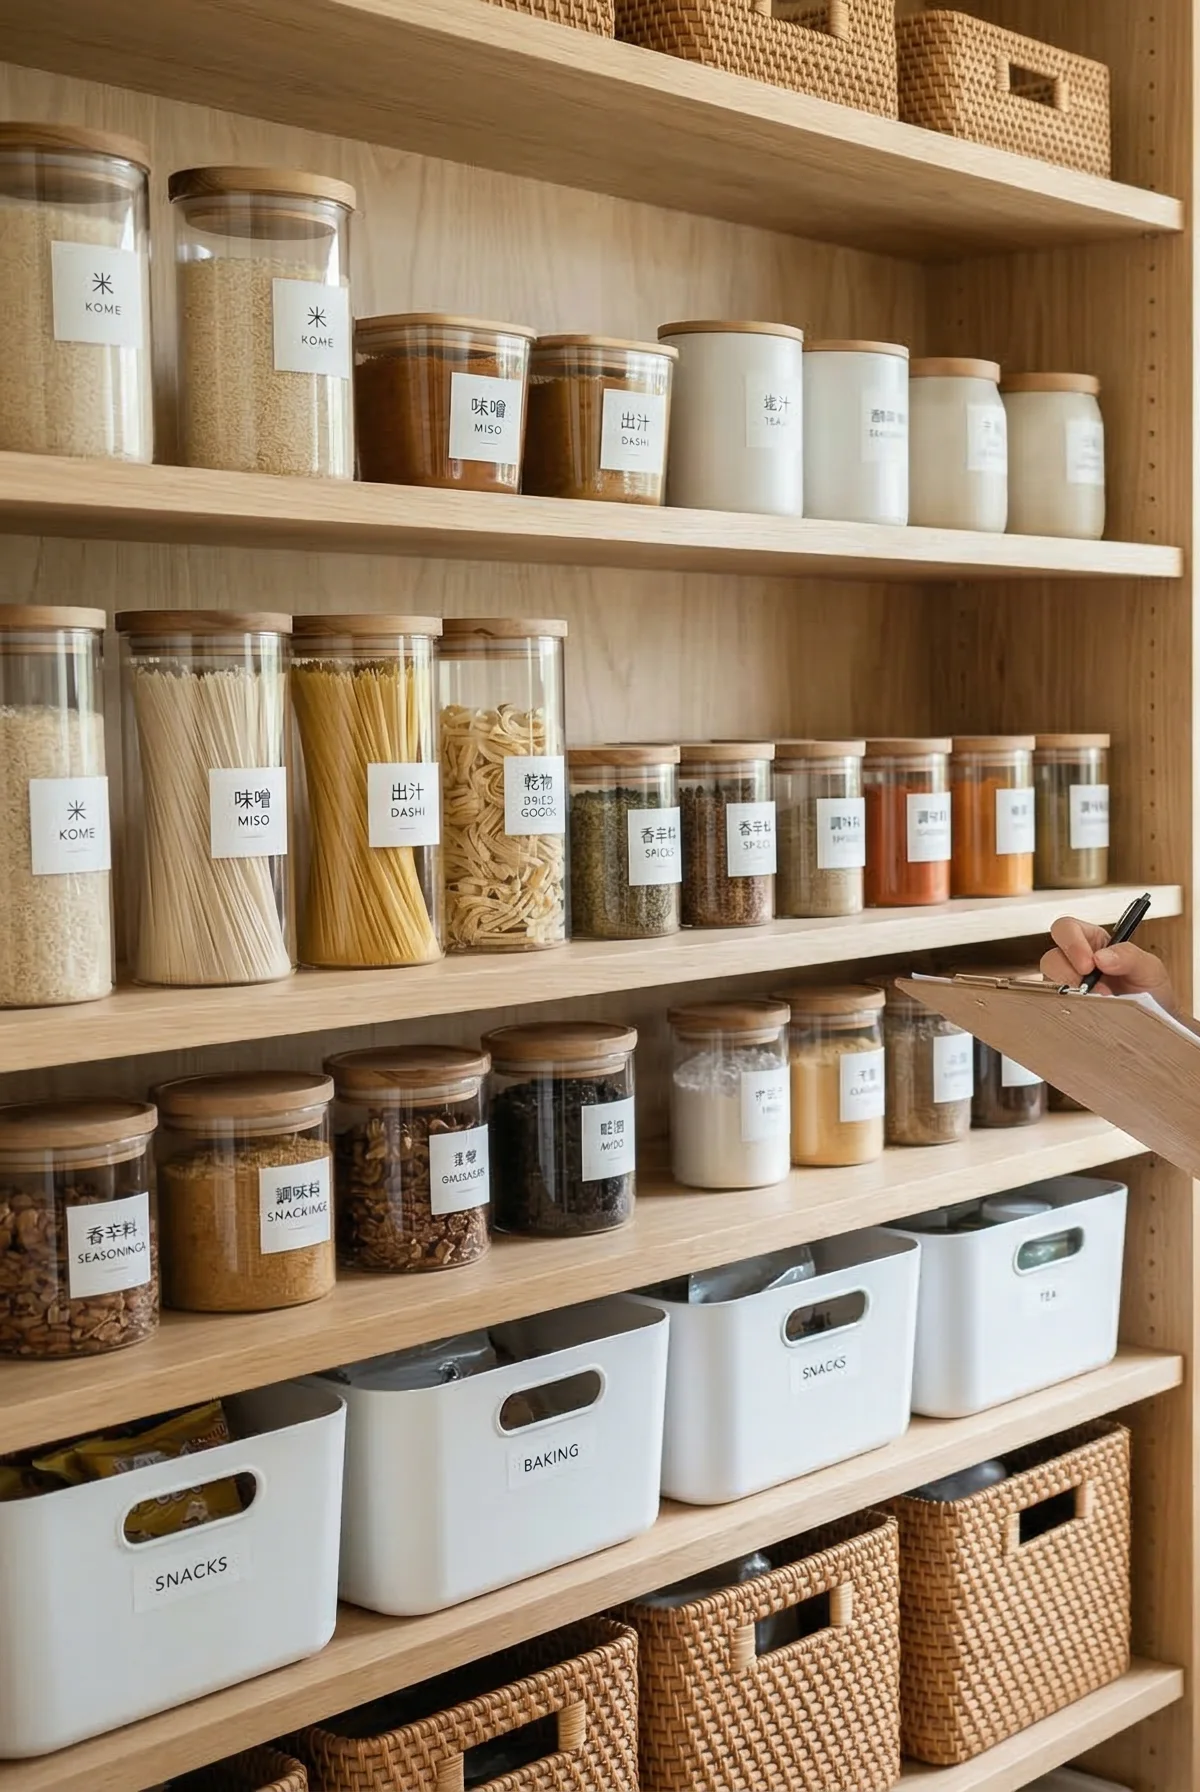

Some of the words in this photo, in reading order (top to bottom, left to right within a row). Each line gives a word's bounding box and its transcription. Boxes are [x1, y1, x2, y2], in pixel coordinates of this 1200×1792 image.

[92, 272, 114, 295] 米
[84, 302, 123, 316] KOME
[307, 305, 327, 328] 米
[300, 334, 335, 348] KOME
[473, 423, 502, 435] MISO
[620, 411, 650, 430] 出汁
[621, 436, 650, 447] DASHI
[234, 787, 271, 809] 味噌
[391, 782, 424, 802] 出汁
[66, 799, 87, 821] 米
[391, 806, 426, 818] DASHI
[237, 814, 271, 827] MISO
[59, 827, 96, 841] KOME
[802, 1355, 847, 1380] SNACKS
[524, 1443, 579, 1472] BAKING
[155, 1556, 228, 1592] SNACKS
